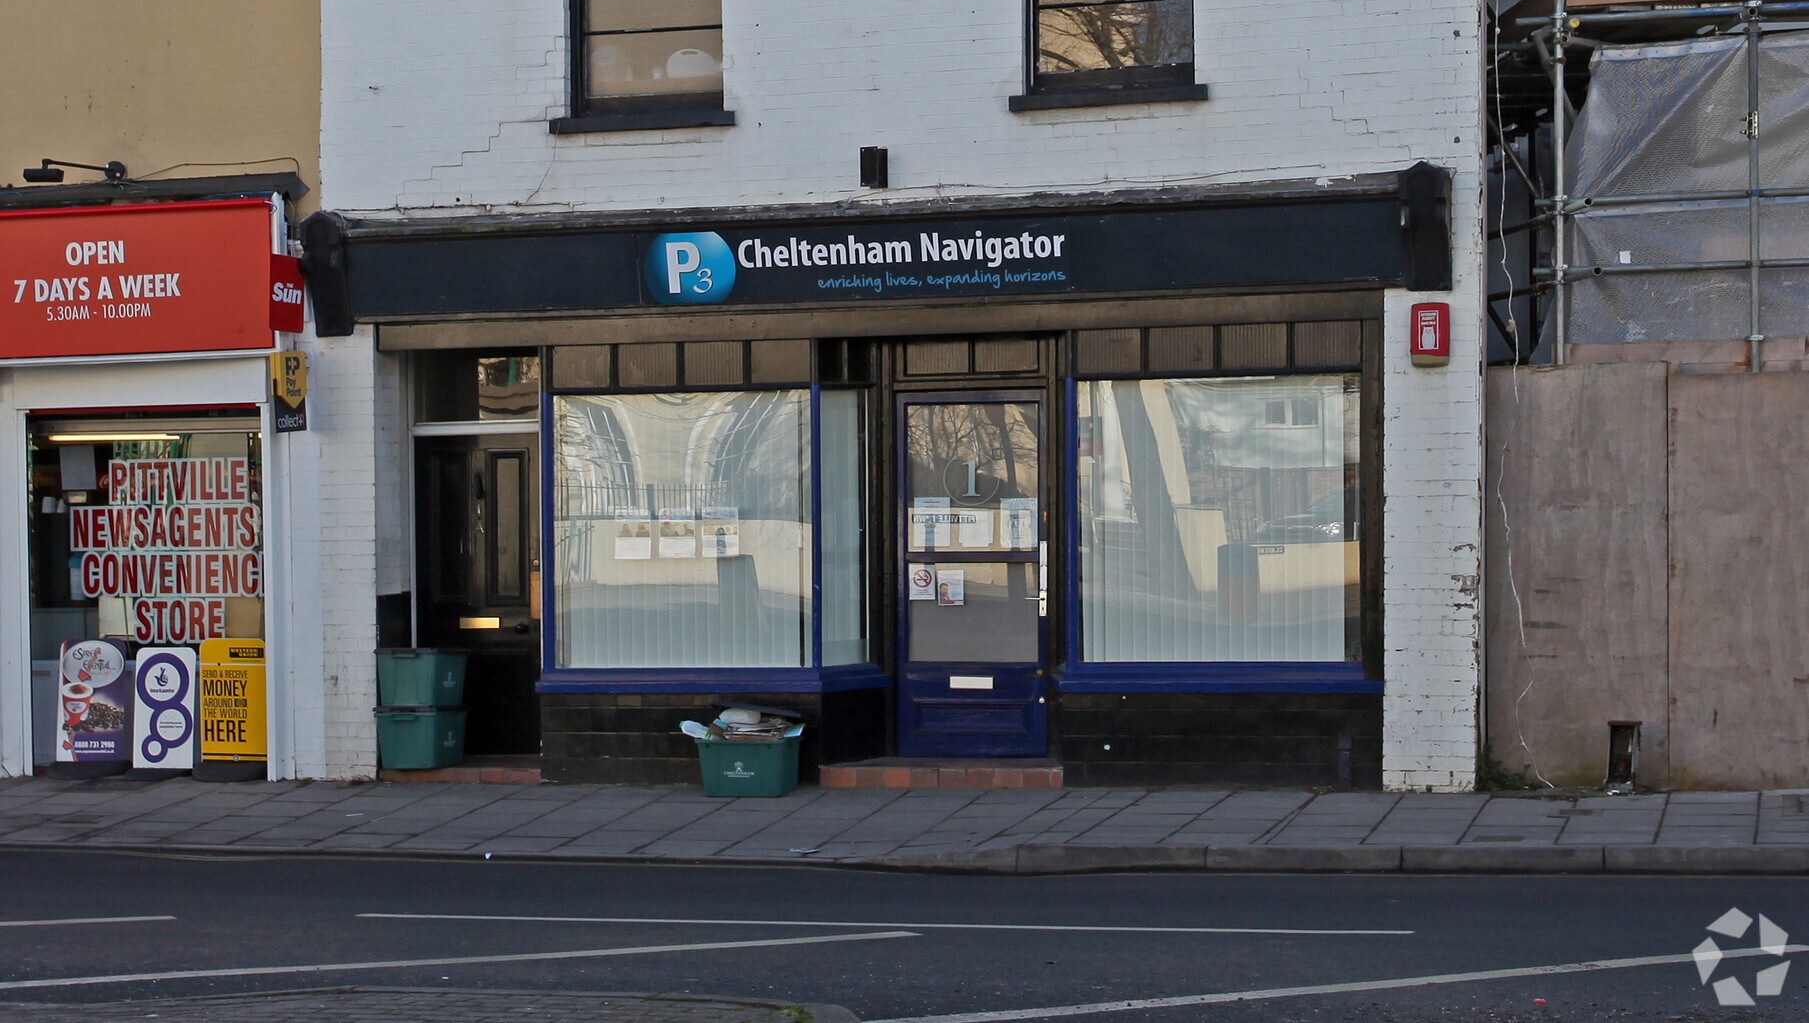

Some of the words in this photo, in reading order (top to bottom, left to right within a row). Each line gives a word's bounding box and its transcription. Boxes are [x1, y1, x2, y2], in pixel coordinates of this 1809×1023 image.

[65, 240, 125, 266] OPEN
[737, 235, 912, 269] Cheltenham
[920, 230, 1066, 268] Navigator
[14, 279, 27, 303] 7
[34, 277, 91, 302] DAYS
[97, 277, 113, 300] A
[118, 273, 181, 299] WEEK
[817, 274, 883, 293] enriching
[886, 271, 923, 289] lives,
[927, 269, 1001, 291] expanding
[1004, 267, 1067, 284] horizons
[272, 282, 302, 304] Sun
[46, 305, 91, 322] 5.30AM
[102, 303, 152, 320] 10.00PM
[286, 377, 296, 388] Pay
[286, 387, 302, 397] Point
[111, 460, 246, 502] PITTVILLE
[961, 459, 981, 497] 1
[72, 506, 256, 549] NEWSAGENTS
[83, 553, 265, 596] CONVENIENC
[136, 600, 223, 642] STORE
[202, 670, 218, 678] SEND
[220, 670, 224, 678] &
[224, 670, 248, 679] RECEIVE
[203, 680, 248, 696] MONEY
[202, 708, 217, 718] THE
[220, 708, 248, 719] WORLD
[204, 698, 233, 708] AROUND
[204, 720, 248, 742] HERE
[74, 740, 89, 748] 0800
